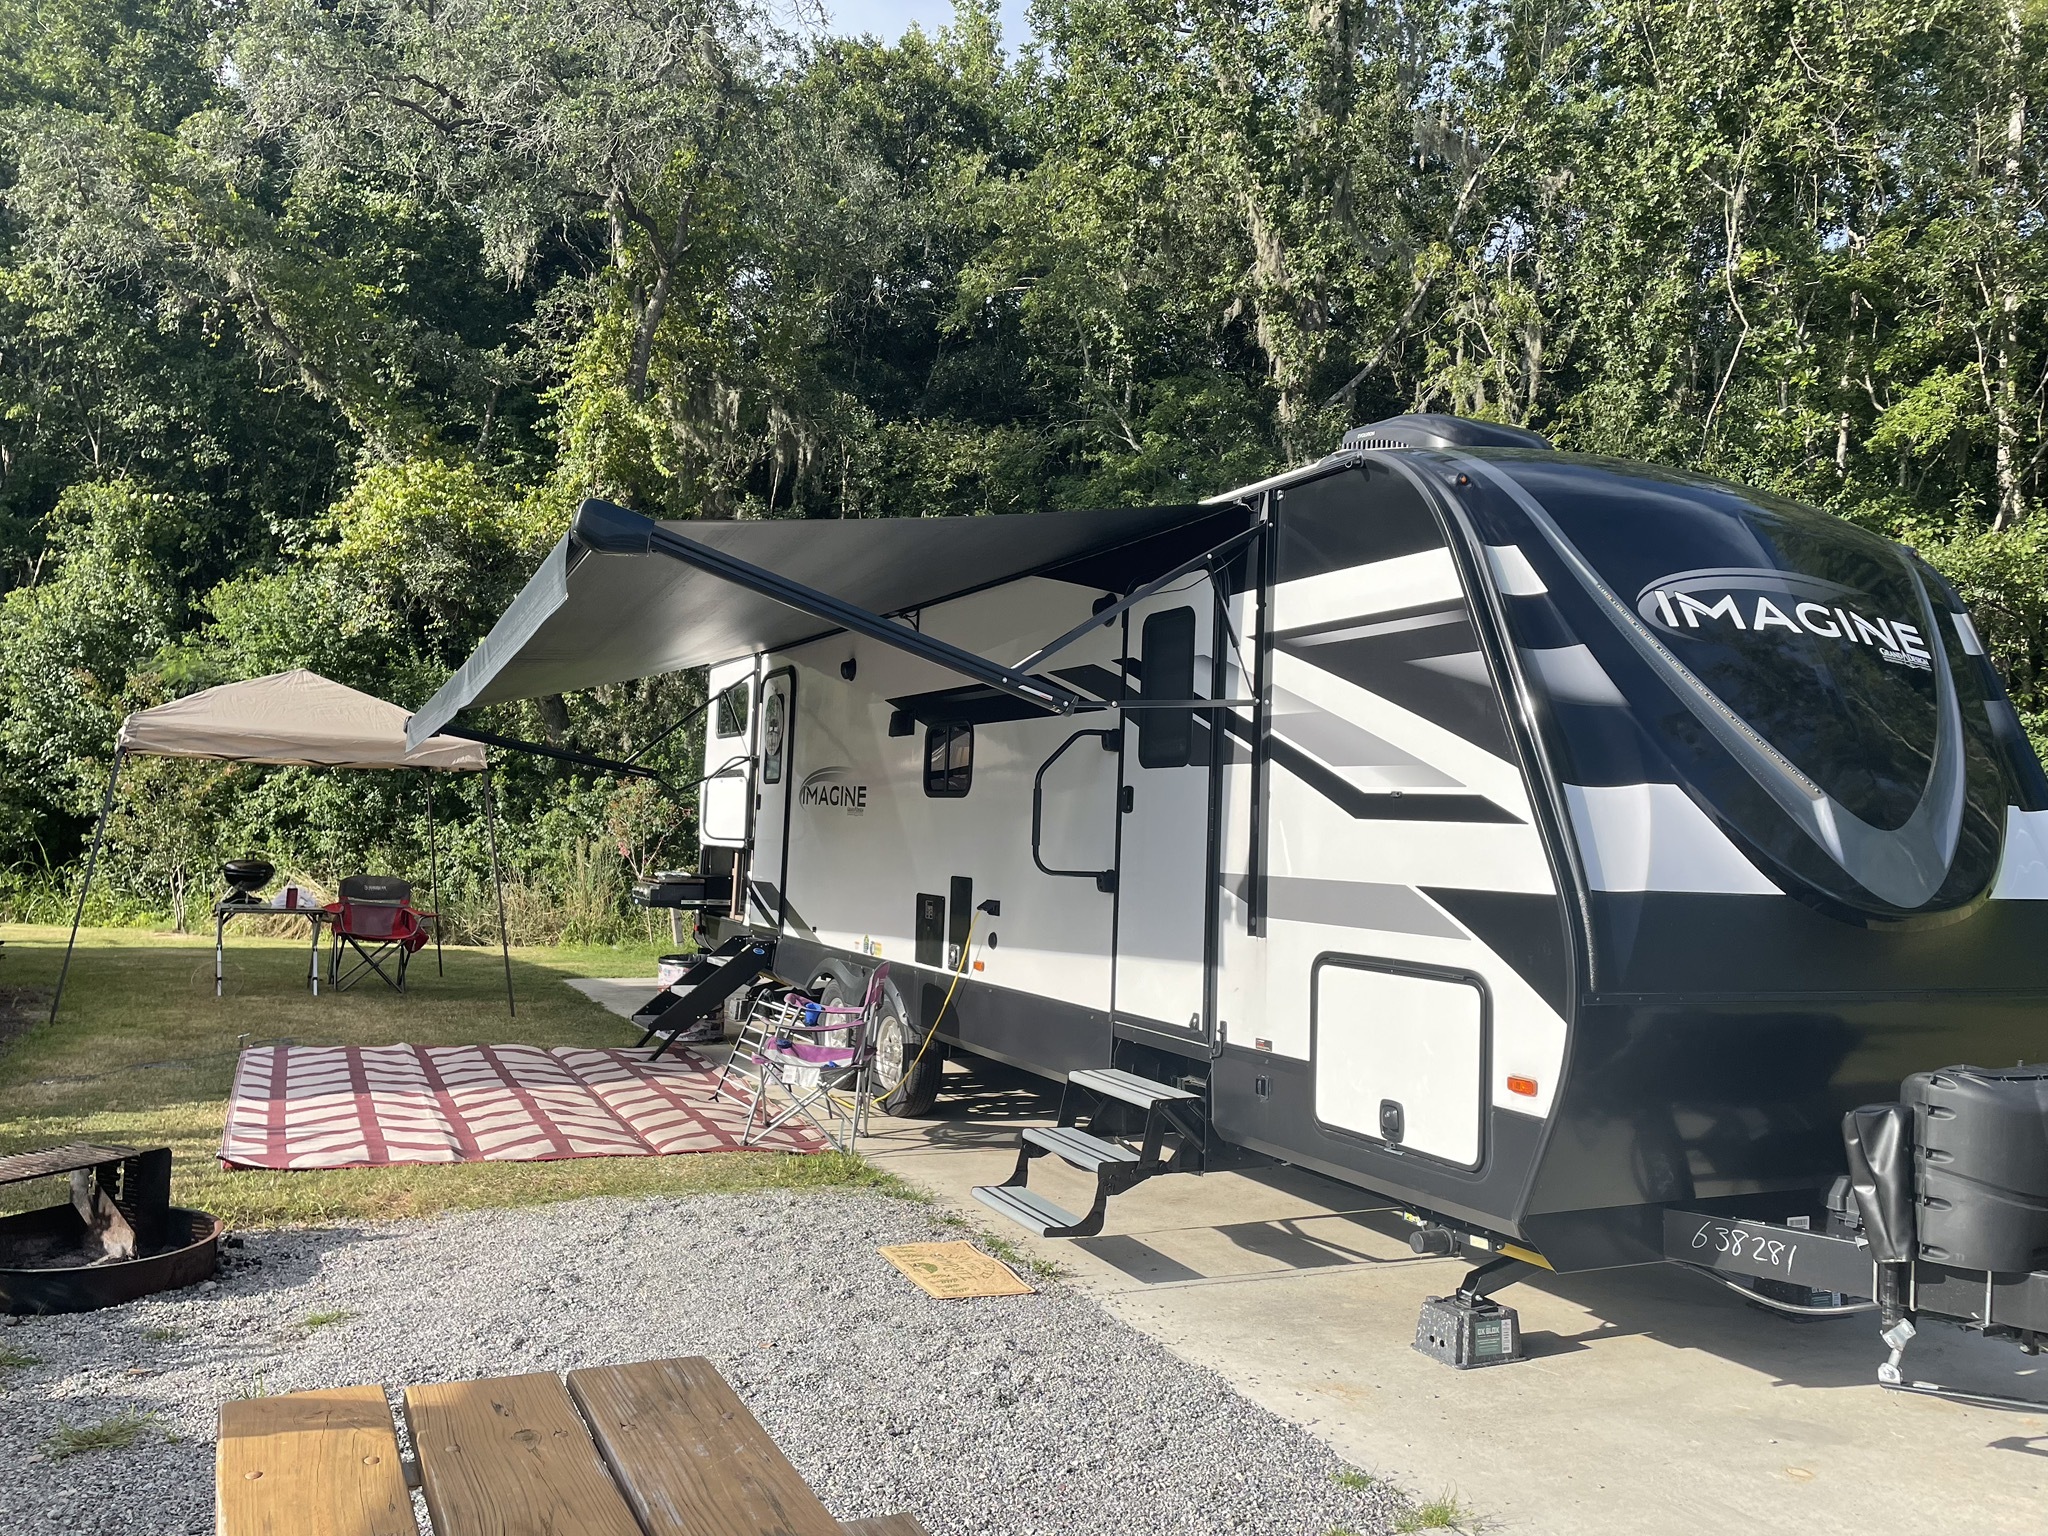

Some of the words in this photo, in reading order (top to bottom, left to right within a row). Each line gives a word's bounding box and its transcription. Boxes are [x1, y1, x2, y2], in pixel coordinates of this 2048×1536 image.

[1654, 590, 1931, 660] IMAGINE
[802, 785, 867, 807] IMAGINE
[1691, 1221, 1797, 1275] 638281
